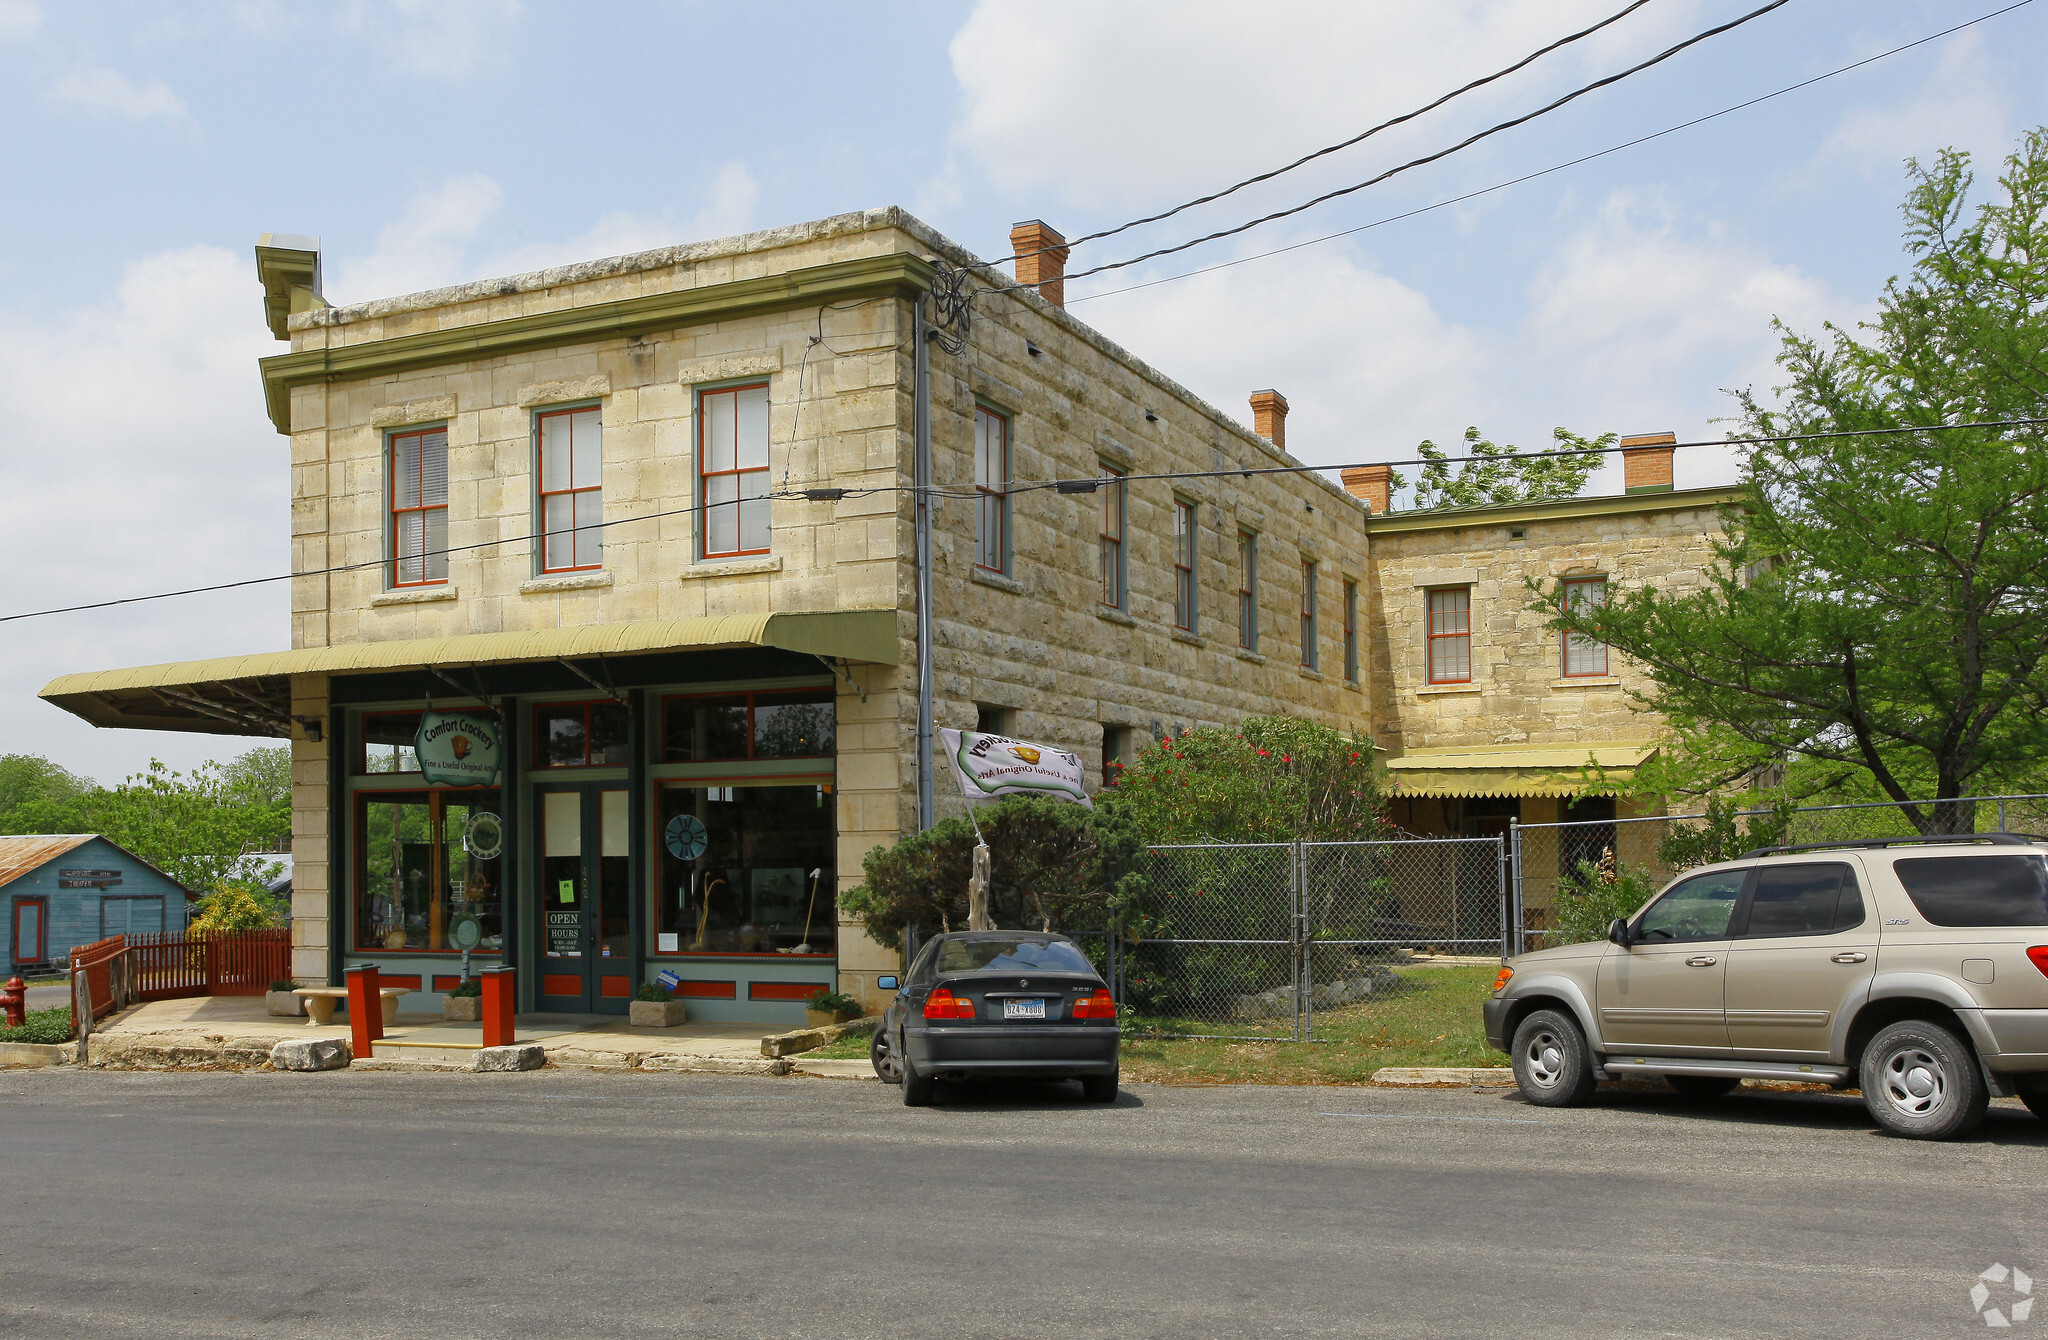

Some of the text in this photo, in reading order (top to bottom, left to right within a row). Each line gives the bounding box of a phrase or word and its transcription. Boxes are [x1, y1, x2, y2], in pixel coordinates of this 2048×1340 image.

[424, 719, 494, 750] Comfort Crockery
[424, 759, 436, 768] Fine
[442, 761, 459, 770] Useful
[460, 762, 482, 773] Original
[550, 914, 578, 924] OPEN
[551, 929, 579, 938] HOURS
